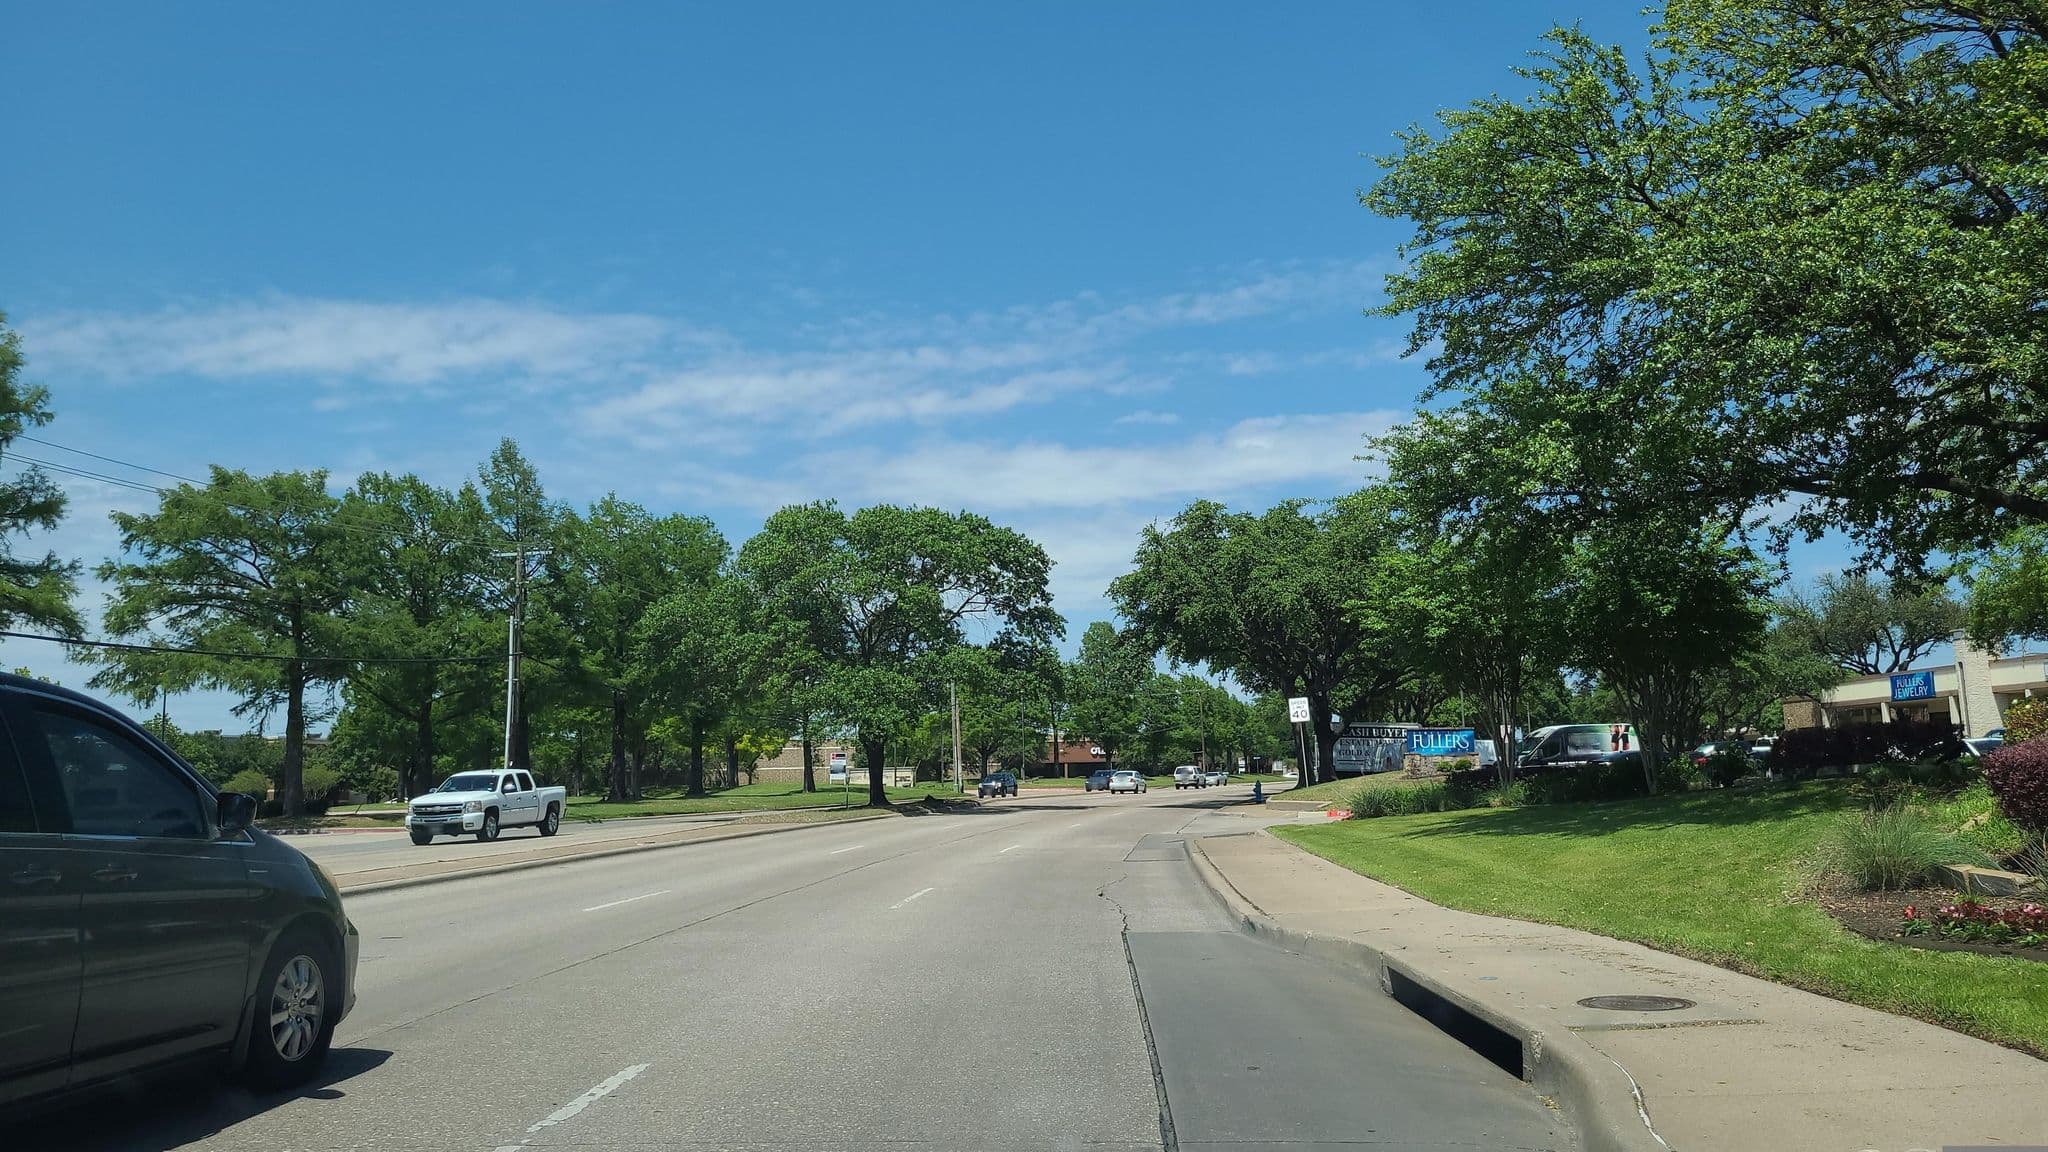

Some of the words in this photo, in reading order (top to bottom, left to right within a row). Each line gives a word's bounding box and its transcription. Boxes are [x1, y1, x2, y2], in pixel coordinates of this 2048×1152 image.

[1894, 685, 1928, 698] JEWELRY
[1292, 709, 1307, 718] 40
[1342, 728, 1370, 737] ASH
